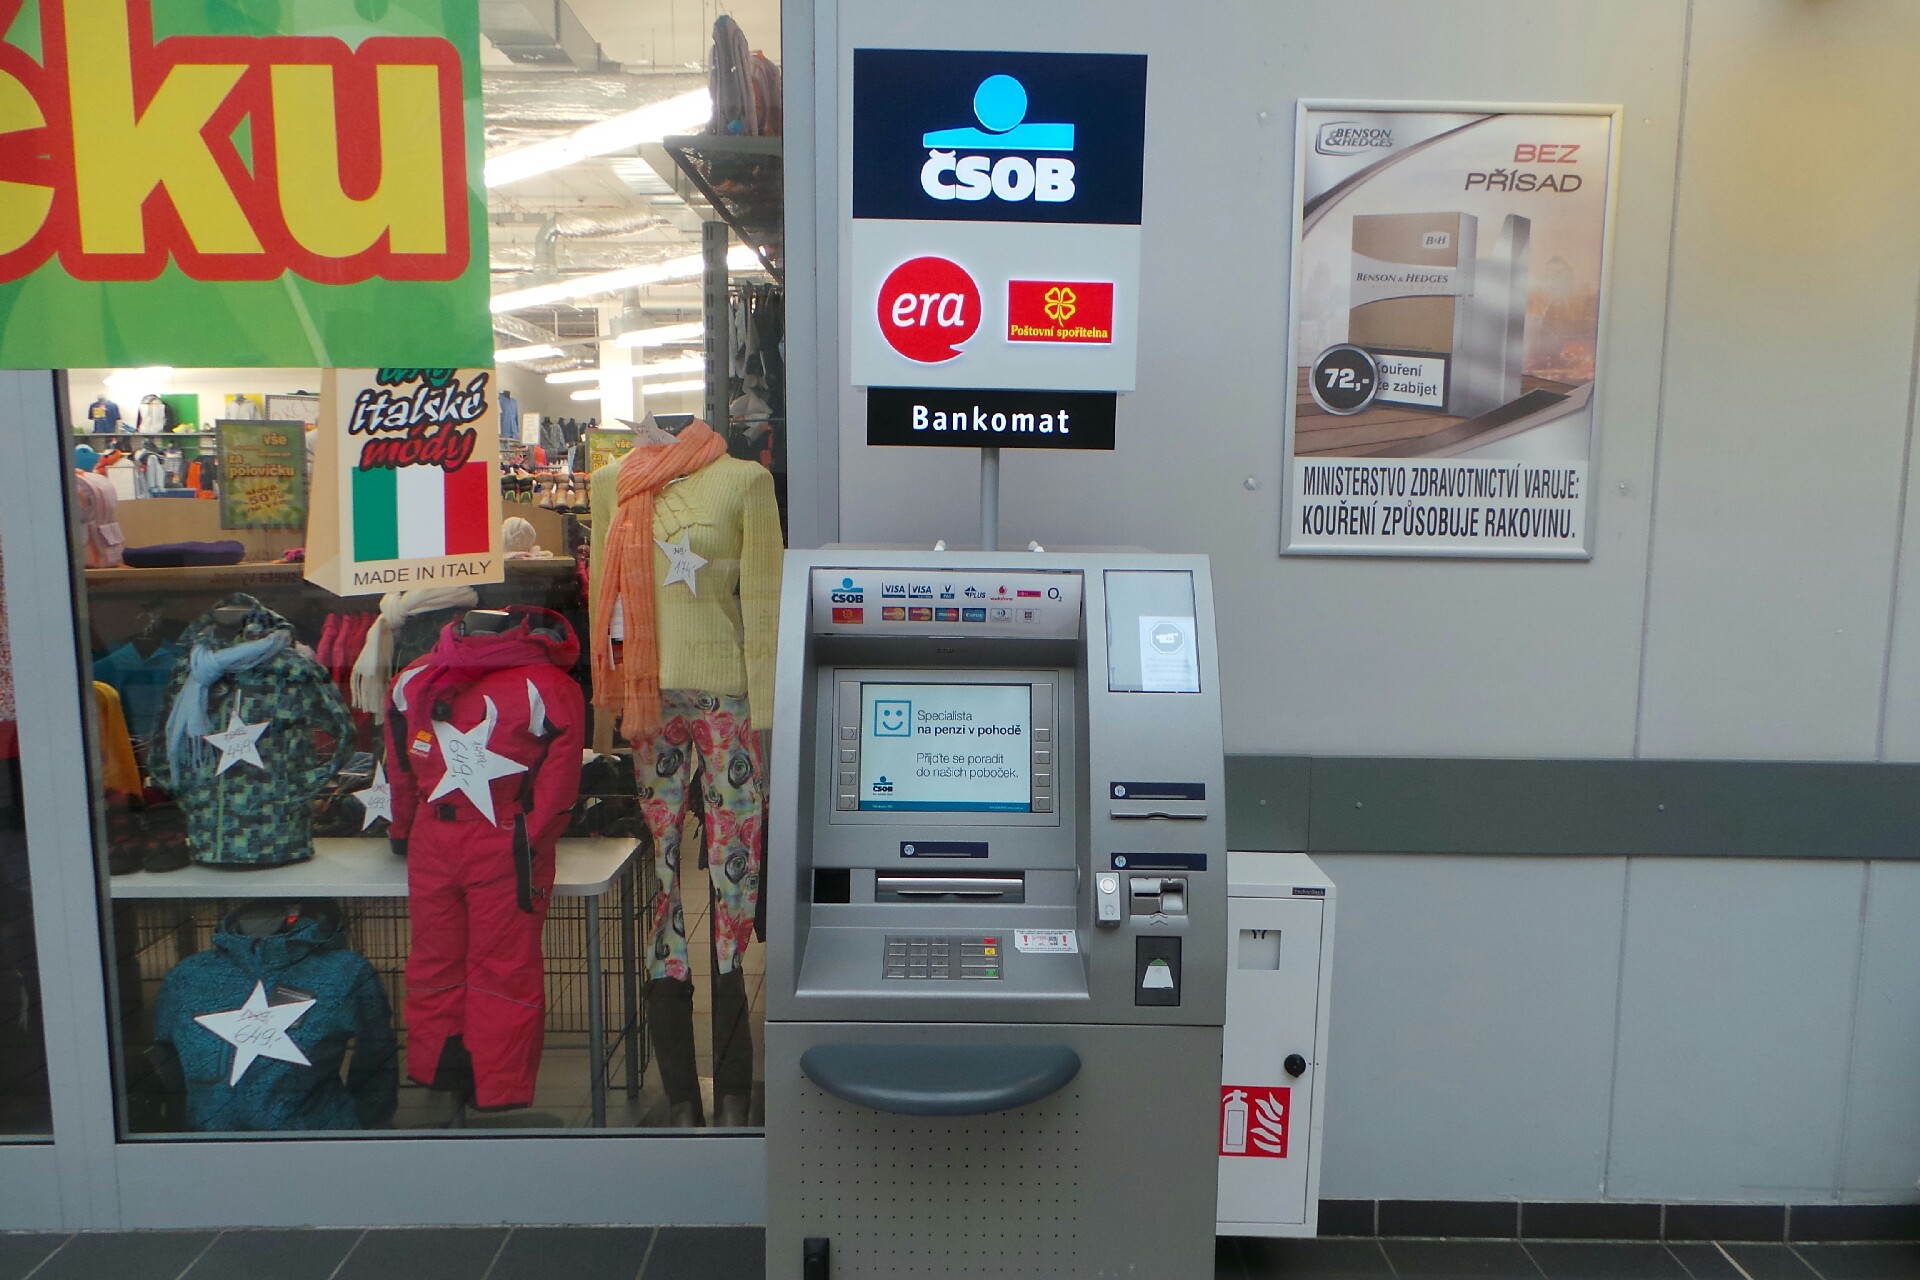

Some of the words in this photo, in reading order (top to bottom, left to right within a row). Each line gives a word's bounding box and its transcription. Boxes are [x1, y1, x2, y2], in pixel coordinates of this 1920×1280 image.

[1336, 128, 1392, 139] BENSON
[1513, 143, 1581, 165] BEZ
[920, 148, 1076, 203] ČSOB
[1464, 168, 1583, 193] PŘÍSAD
[1405, 273, 1449, 284] HEDGES
[891, 292, 965, 327] era
[1010, 323, 1055, 338] Poštovní
[1056, 325, 1109, 340] spořitelna
[1324, 368, 1370, 392] 72,-
[1393, 380, 1438, 397] zabíjet
[350, 375, 487, 434] italské
[912, 404, 1070, 434] Bankomat
[262, 433, 288, 446] vše
[359, 422, 477, 472] módy
[229, 464, 295, 480] polovičku
[1303, 466, 1406, 497] MINISTERSTVO
[1410, 463, 1522, 499] ZDRAVOTNICTVÍ
[1524, 468, 1580, 500] VARUJE:
[1302, 499, 1377, 537] KOUŘENÍ
[1382, 499, 1480, 538] ZPŮSOBUJE
[1485, 507, 1576, 539] RAKOVINU.
[353, 567, 410, 586] MADE
[416, 565, 435, 581] IN
[441, 560, 492, 577] ITALY
[885, 584, 905, 593] VISA
[912, 585, 932, 594] VISA
[969, 591, 986, 599] PLUS
[831, 592, 864, 604] ČSOB
[917, 709, 973, 723] Specialista
[917, 727, 931, 735] na
[934, 725, 966, 736] penzi
[977, 724, 1022, 737] pohodě
[952, 755, 965, 764] se
[967, 753, 1005, 766] poradit
[916, 767, 931, 777] do
[933, 767, 967, 778] našich
[969, 768, 1019, 780] poboček.
